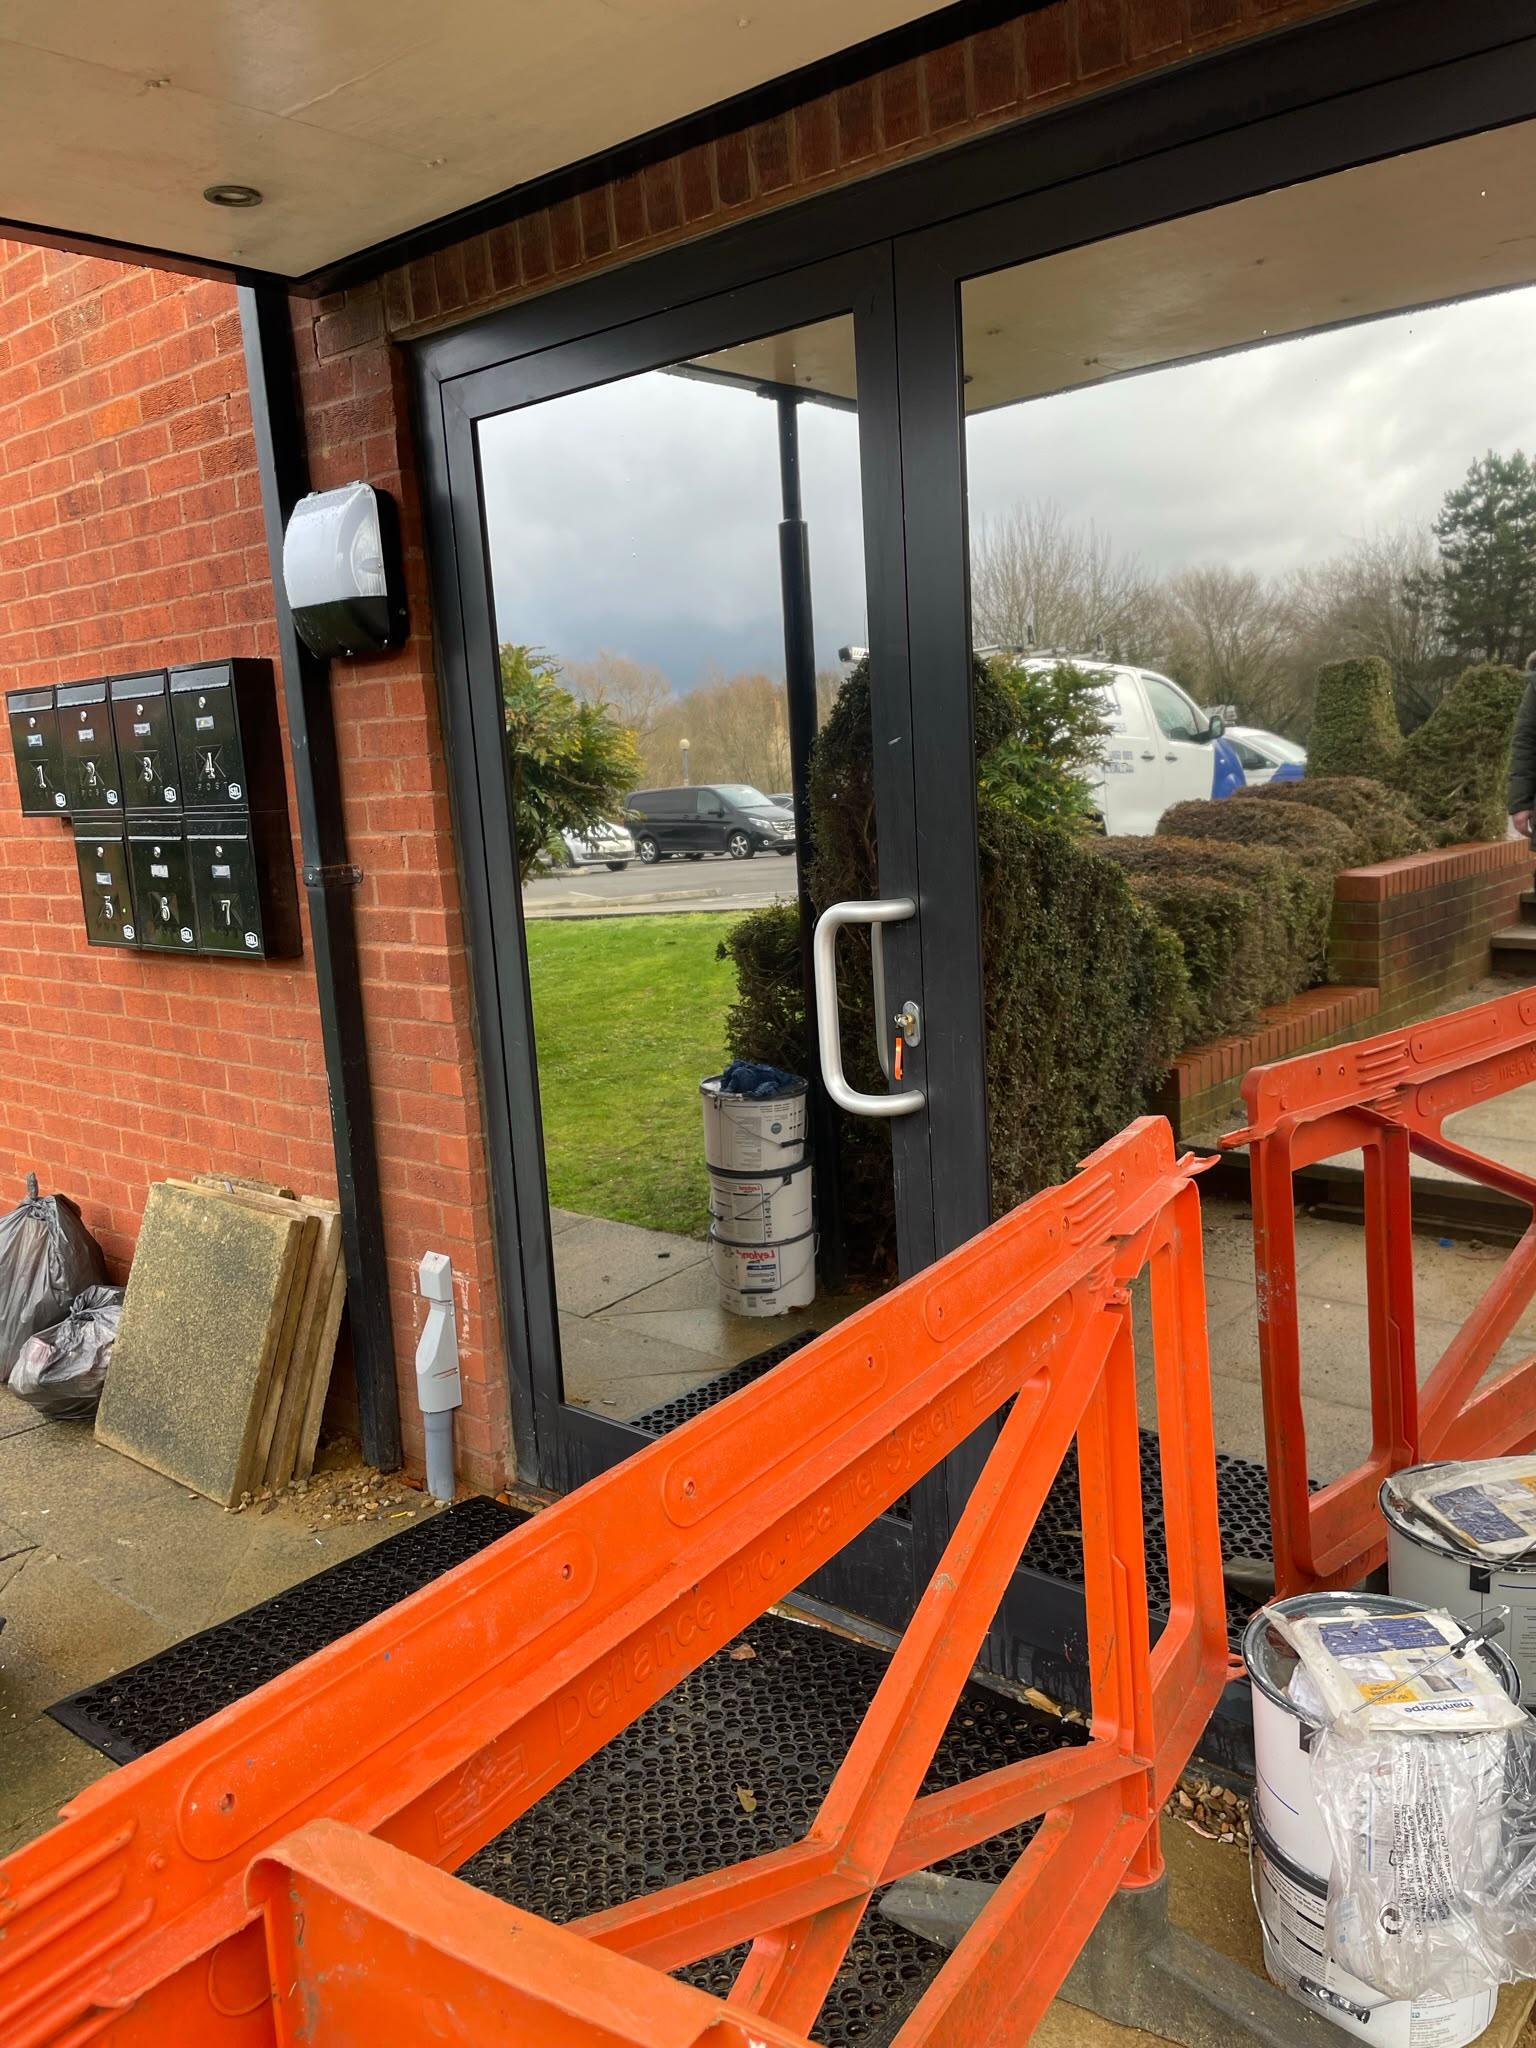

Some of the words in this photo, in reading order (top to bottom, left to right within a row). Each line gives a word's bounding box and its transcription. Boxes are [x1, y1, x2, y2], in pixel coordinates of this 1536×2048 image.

[37, 765, 46, 788] 1
[86, 762, 96, 786] 2
[143, 757, 153, 781] 3
[205, 752, 215, 779] 4
[104, 896, 113, 919] 5
[161, 897, 170, 921] 6
[221, 900, 231, 925] 7
[886, 1398, 961, 1474] System
[1404, 1701, 1474, 1714] manthorpe
